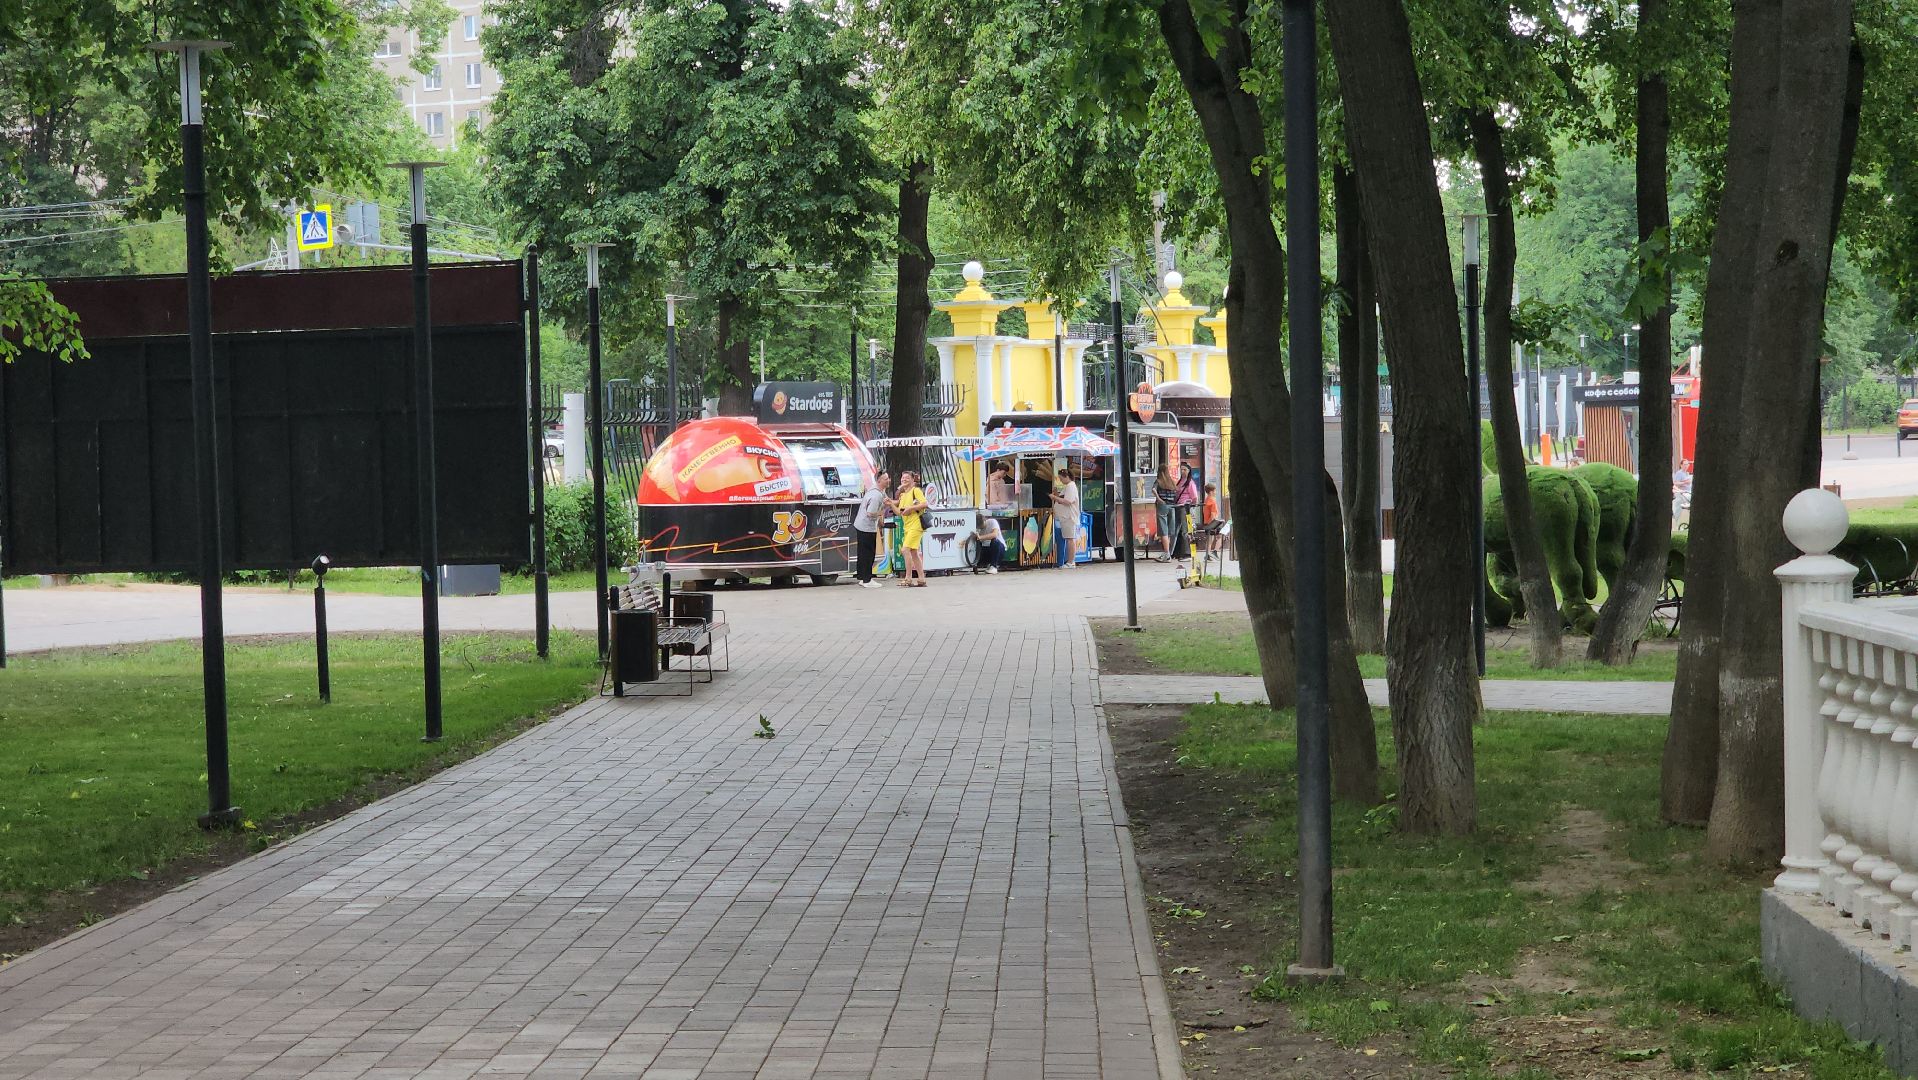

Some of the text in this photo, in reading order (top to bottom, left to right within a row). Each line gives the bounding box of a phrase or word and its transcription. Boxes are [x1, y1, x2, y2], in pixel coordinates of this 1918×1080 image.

[1584, 389, 1606, 398] кофе
[1613, 387, 1639, 396] собой
[789, 396, 833, 413] Stardogs
[682, 439, 737, 479] КАЧЕСТВЕННО
[745, 446, 779, 459] ВКУСНО
[759, 480, 789, 493] БЫСТРО
